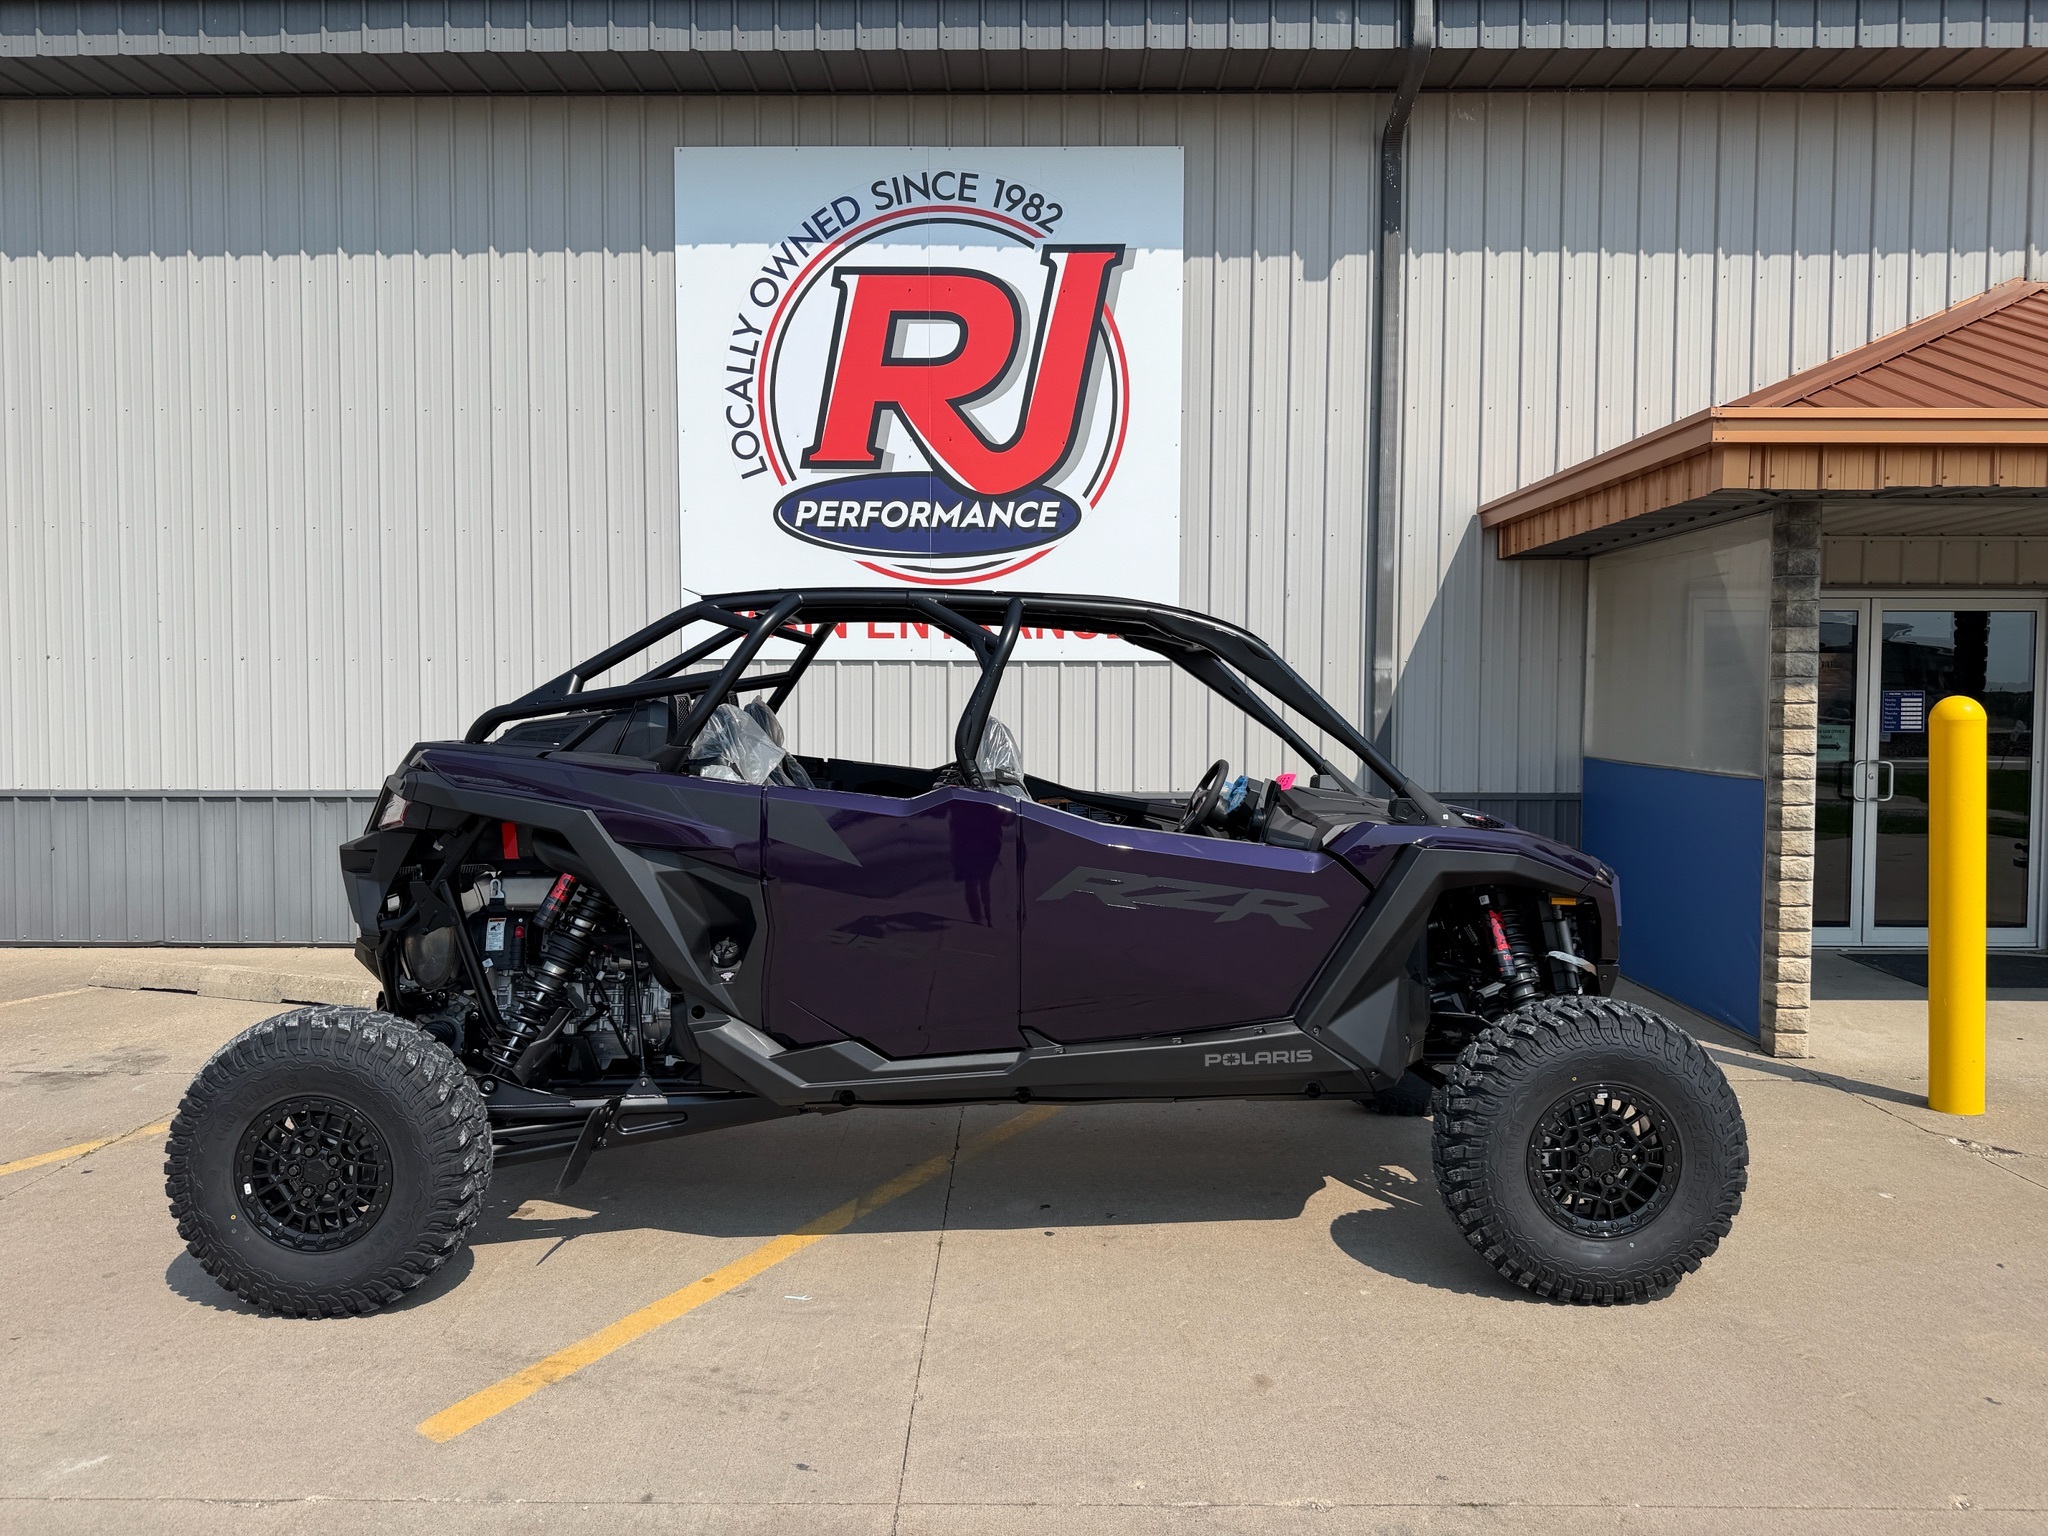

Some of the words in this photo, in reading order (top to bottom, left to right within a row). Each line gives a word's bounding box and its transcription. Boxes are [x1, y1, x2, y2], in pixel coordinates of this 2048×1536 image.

[725, 313, 768, 480] LOCALLY
[750, 195, 861, 308] OWNED
[870, 170, 979, 210] SINCE
[992, 178, 1064, 234] 1982
[799, 243, 1128, 501] RJ
[794, 500, 1061, 530] PERFORMANCE
[1036, 866, 1331, 930] RZR
[1204, 1049, 1313, 1067] POLARIS
